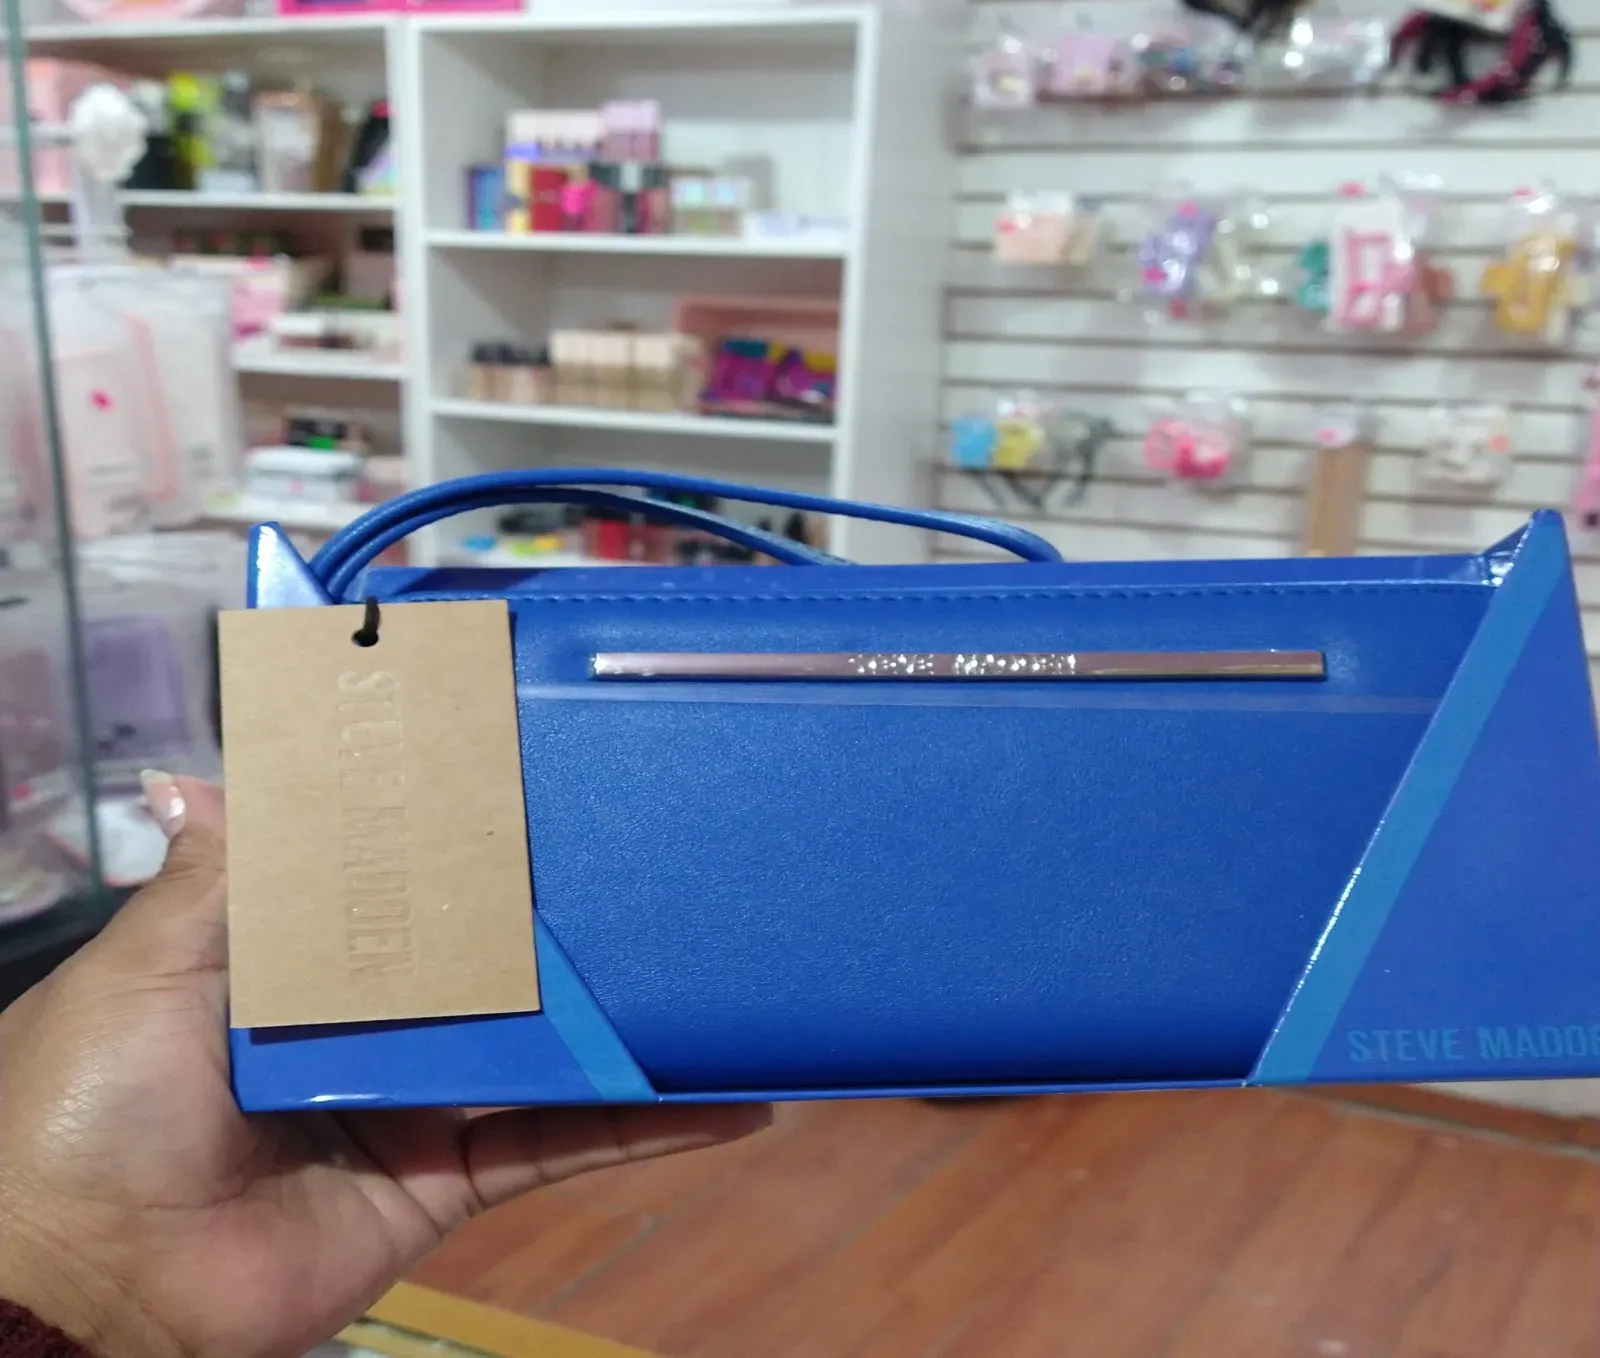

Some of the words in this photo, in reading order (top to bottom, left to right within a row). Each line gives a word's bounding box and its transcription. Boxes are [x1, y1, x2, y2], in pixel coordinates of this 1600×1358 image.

[336, 668, 405, 791] STEVE
[342, 805, 418, 977] MADDEN
[1349, 1027, 1464, 1062] STEVE
